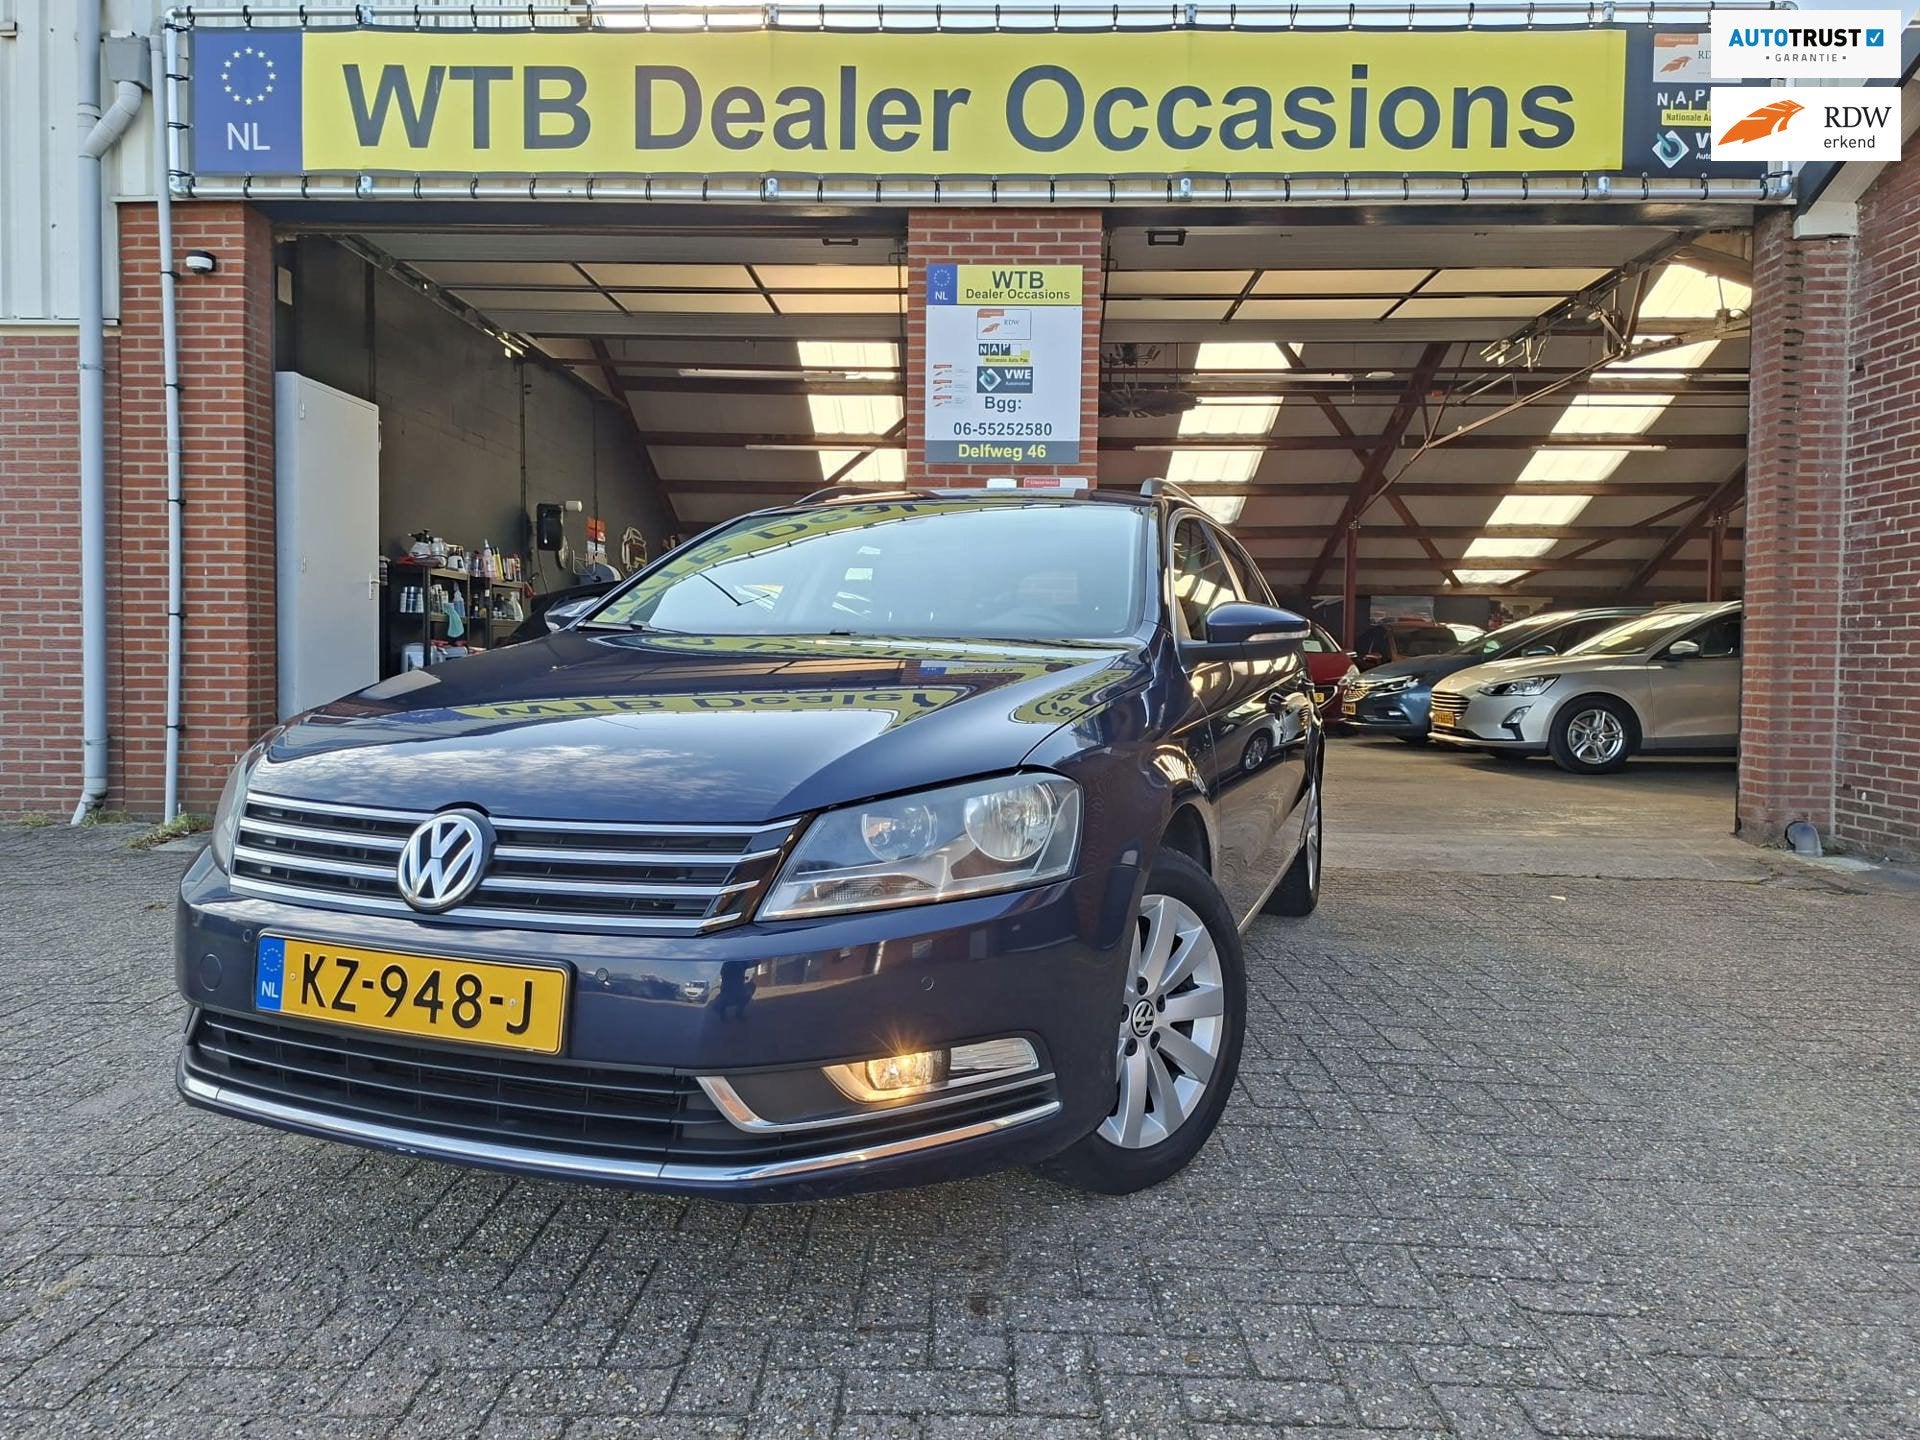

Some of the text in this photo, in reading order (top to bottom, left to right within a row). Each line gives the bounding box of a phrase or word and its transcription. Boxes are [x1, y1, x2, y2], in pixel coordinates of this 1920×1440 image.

[341, 63, 1576, 153] WTB Dealer Occasions
[1665, 113, 1702, 122] Nationale
[227, 122, 271, 151] NL
[1696, 132, 1711, 149] V
[991, 270, 1045, 289] WTB
[935, 291, 948, 300] NL
[965, 289, 1071, 300] Dealer Occasions
[1004, 369, 1032, 379] VWE
[984, 396, 1022, 412] Bgg:
[953, 422, 1053, 436] 06-55252580
[958, 444, 1047, 461] Delfweg 46
[261, 980, 280, 999] NL
[300, 952, 533, 1035] KZ-948-J
